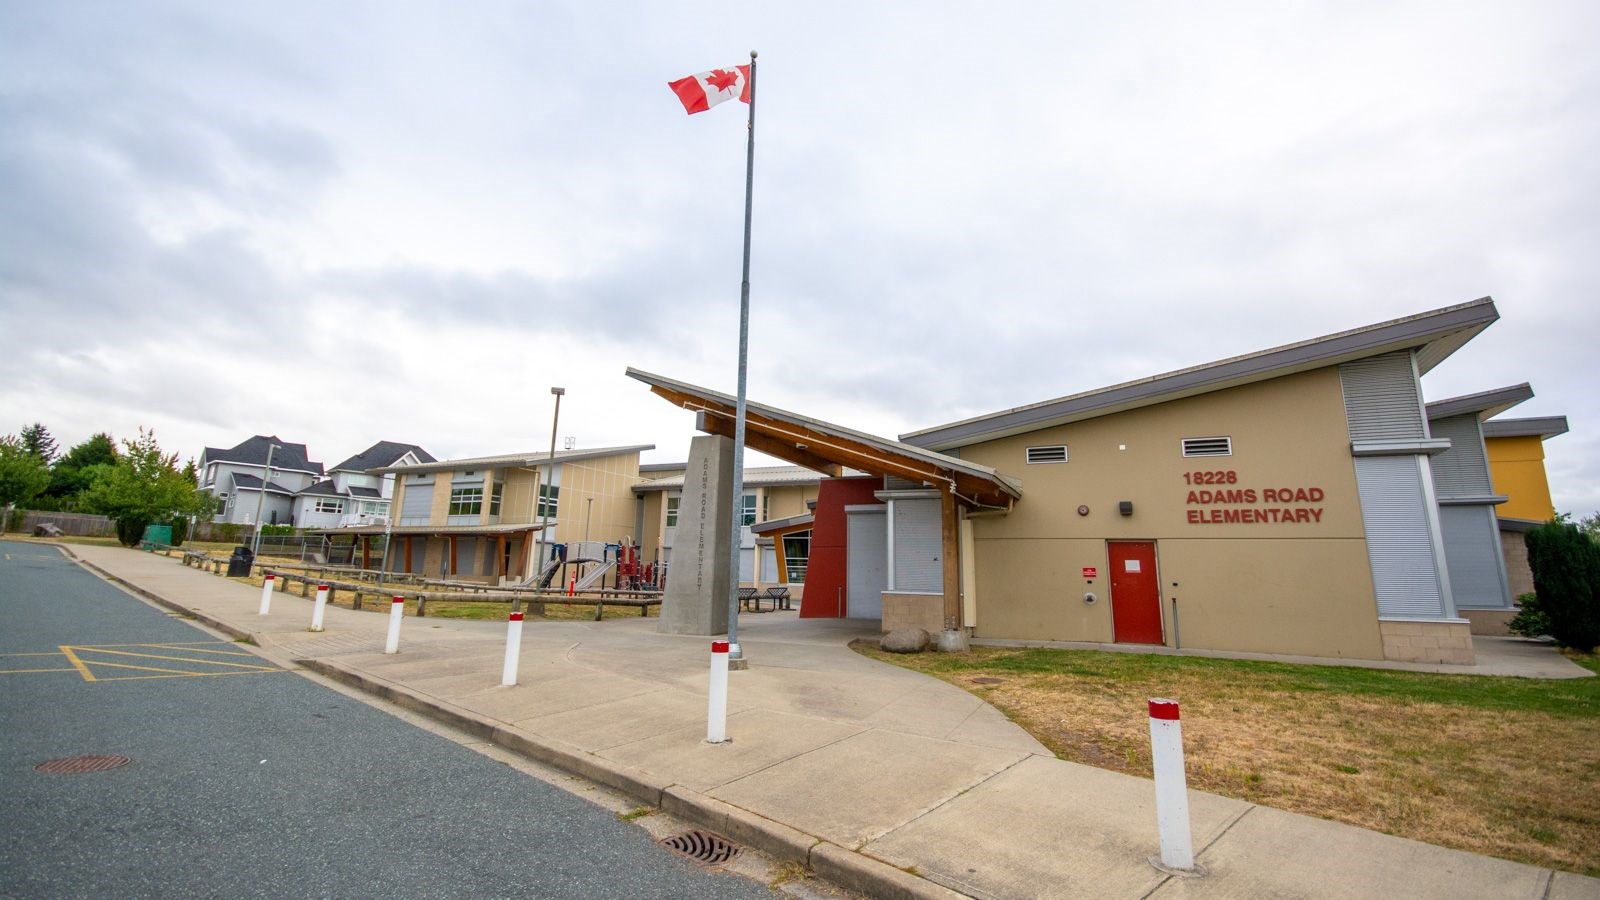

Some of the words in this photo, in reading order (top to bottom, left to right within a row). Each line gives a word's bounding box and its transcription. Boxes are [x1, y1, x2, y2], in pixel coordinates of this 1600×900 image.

[1183, 470, 1237, 485] 18228
[1186, 488, 1257, 504] ADAMS
[1263, 487, 1324, 503] ROAD
[1187, 508, 1324, 524] ELEMENTARY
